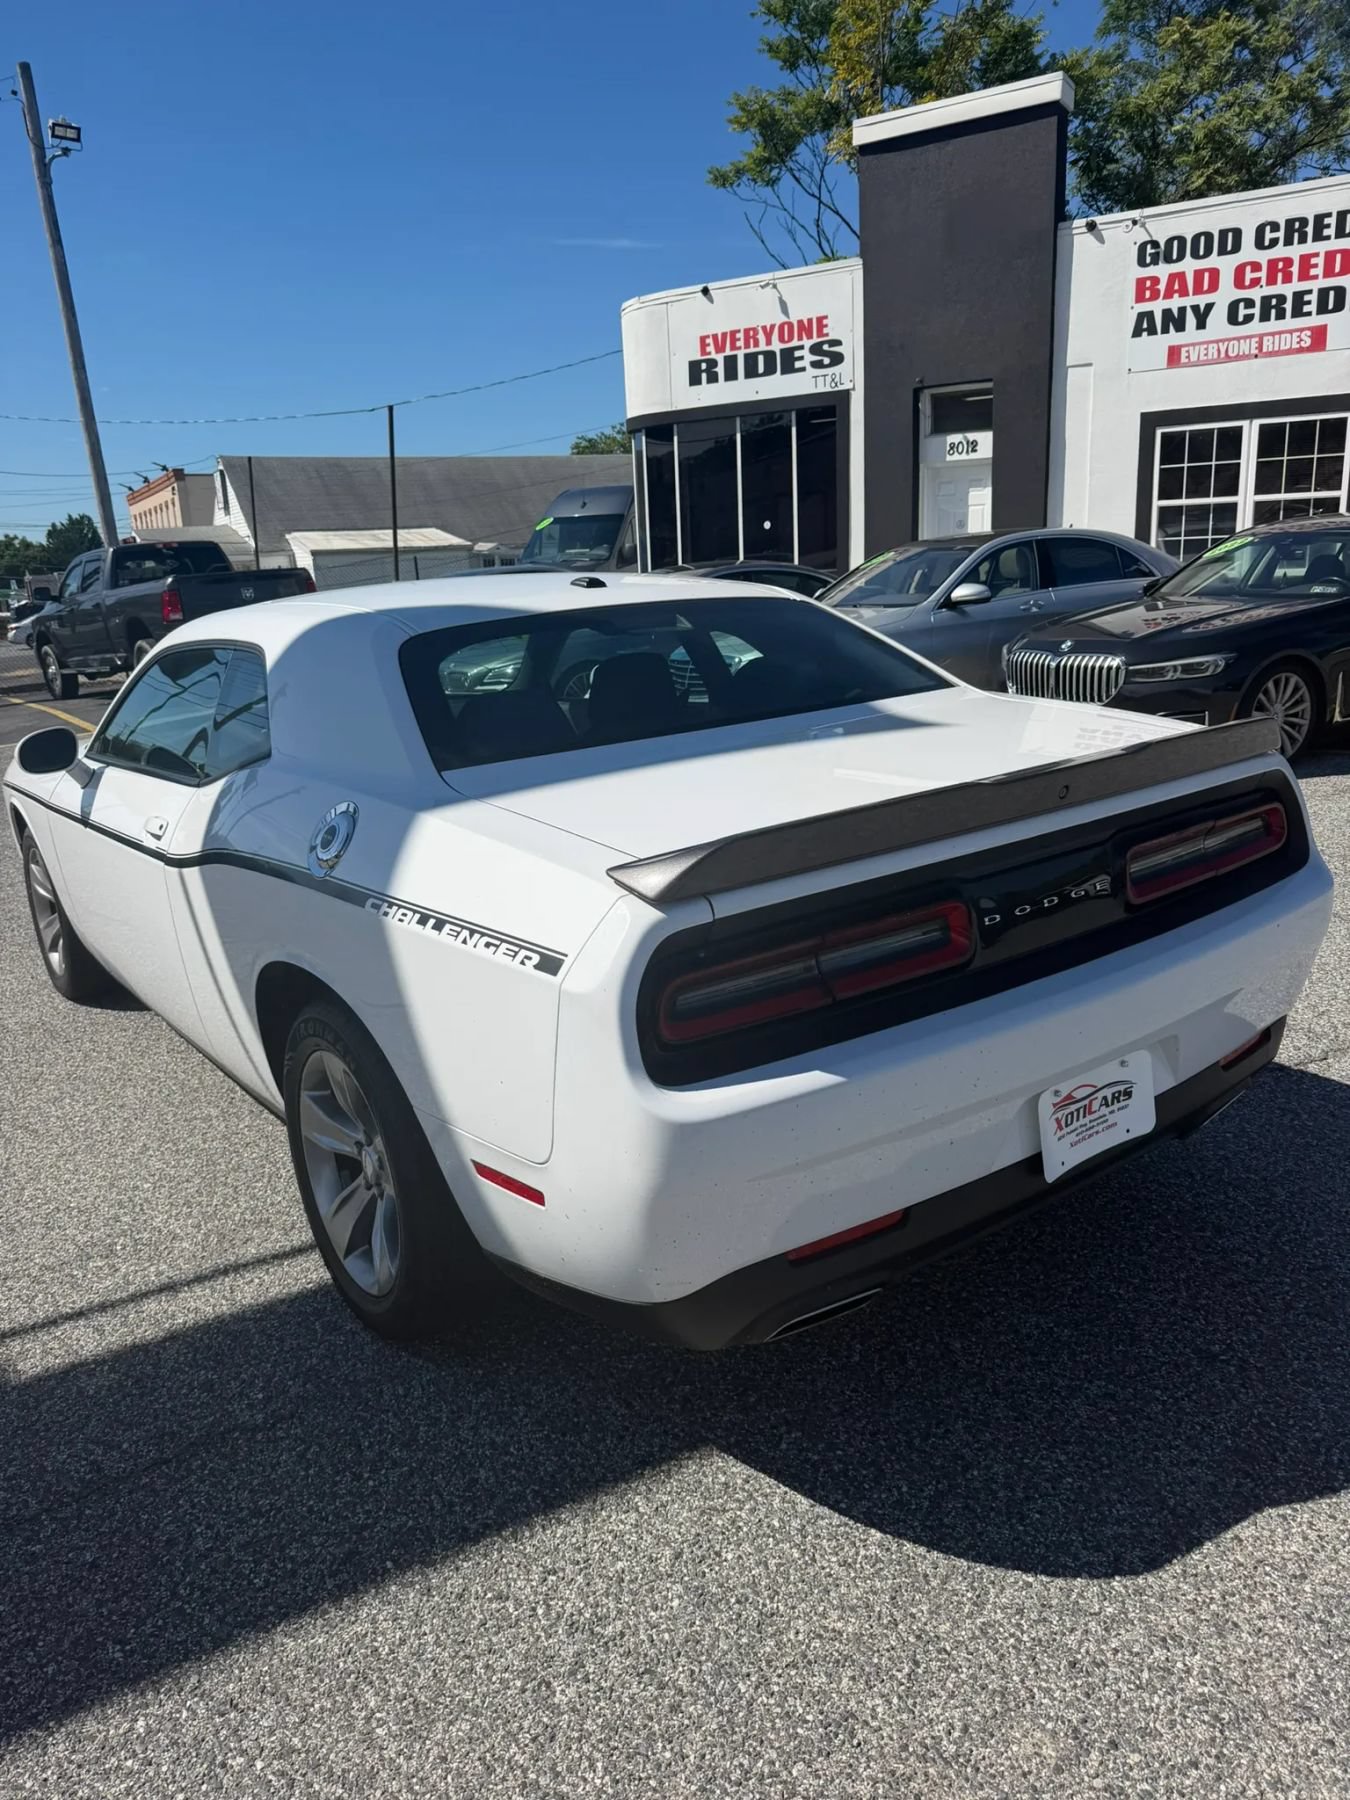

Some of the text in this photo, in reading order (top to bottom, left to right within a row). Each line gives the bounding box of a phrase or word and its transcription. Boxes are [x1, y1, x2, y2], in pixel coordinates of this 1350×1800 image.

[1136, 227, 1243, 269] GOOD
[1134, 248, 1350, 305] BAD CRED
[699, 314, 830, 358] EVERYONE
[1131, 302, 1217, 339] ANY
[688, 338, 845, 387] RIDES
[1180, 330, 1312, 364] EVERYONE RIDES
[811, 372, 845, 389] TT&L
[947, 439, 979, 456] 8012
[984, 878, 1110, 926] DODGE
[364, 897, 541, 971] CHALLENGER
